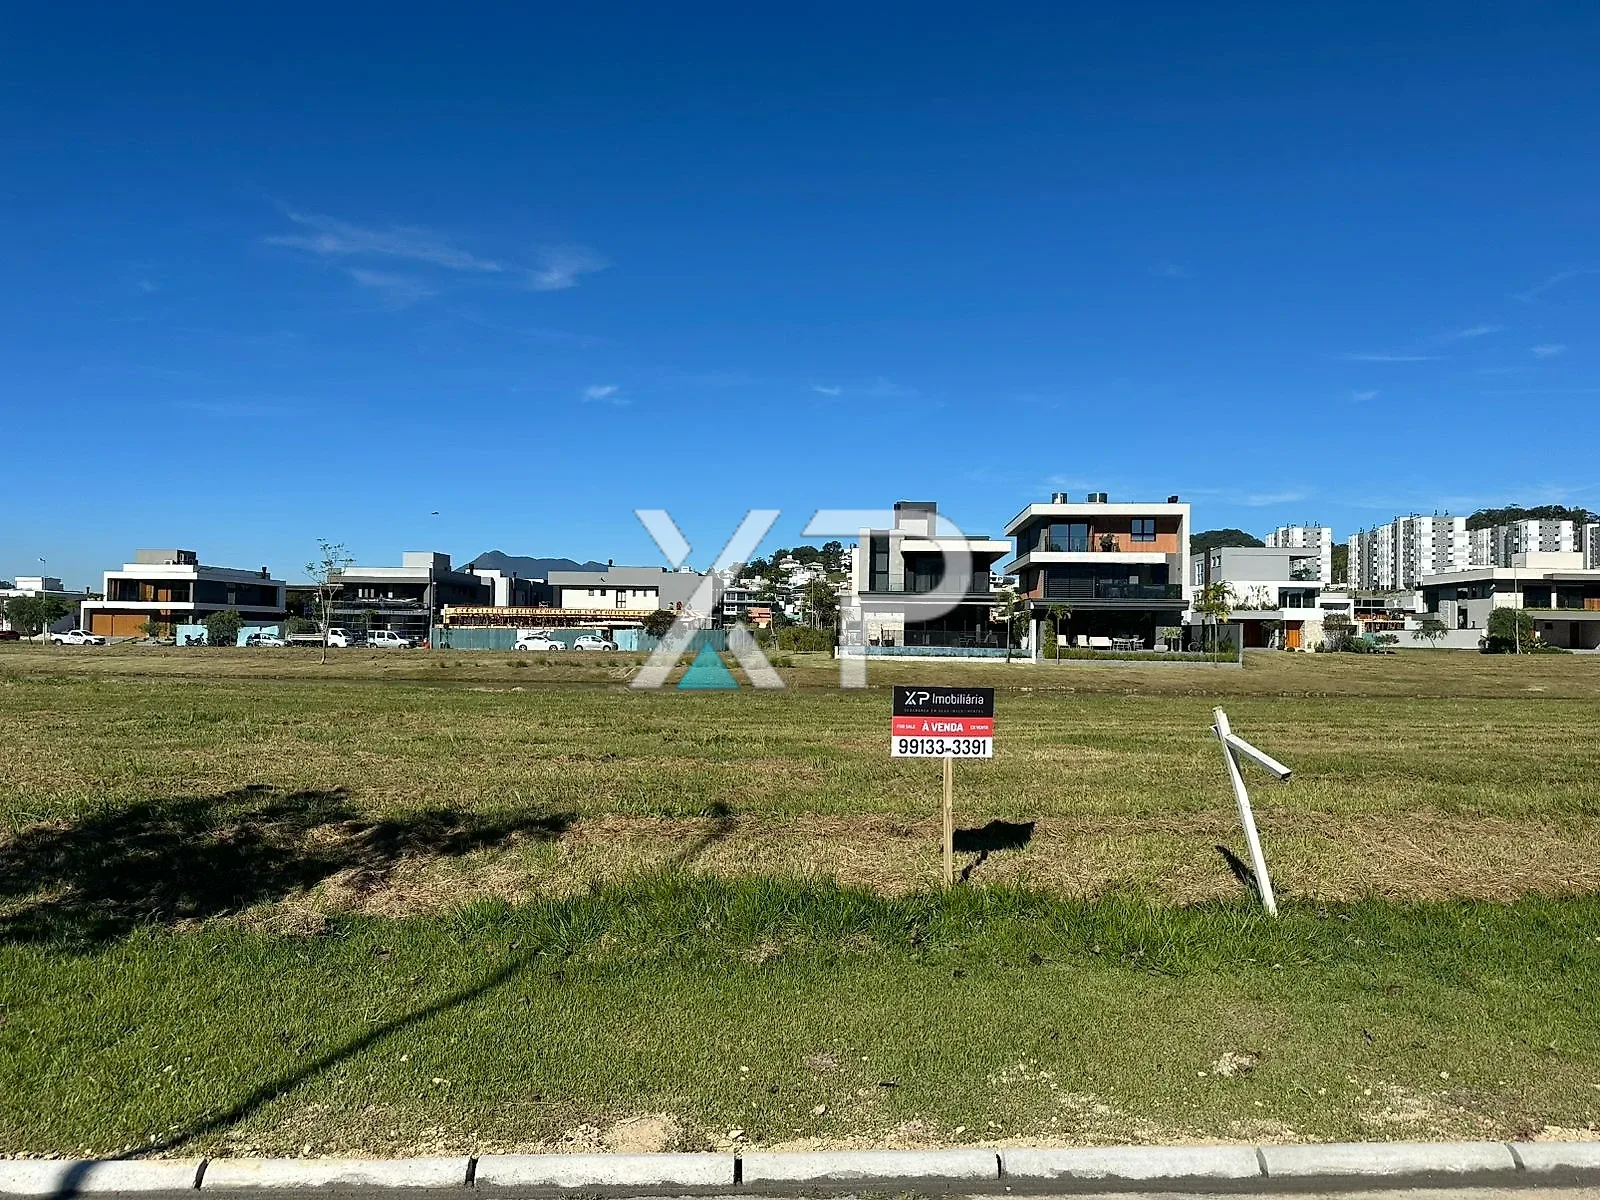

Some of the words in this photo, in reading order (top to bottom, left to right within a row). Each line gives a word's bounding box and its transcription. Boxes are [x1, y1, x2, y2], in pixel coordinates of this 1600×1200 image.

[904, 690, 930, 706] XP
[932, 692, 984, 705] Imobiliária
[921, 720, 930, 732] À
[931, 722, 964, 733] VENDA
[898, 738, 986, 755] 99133-3391
